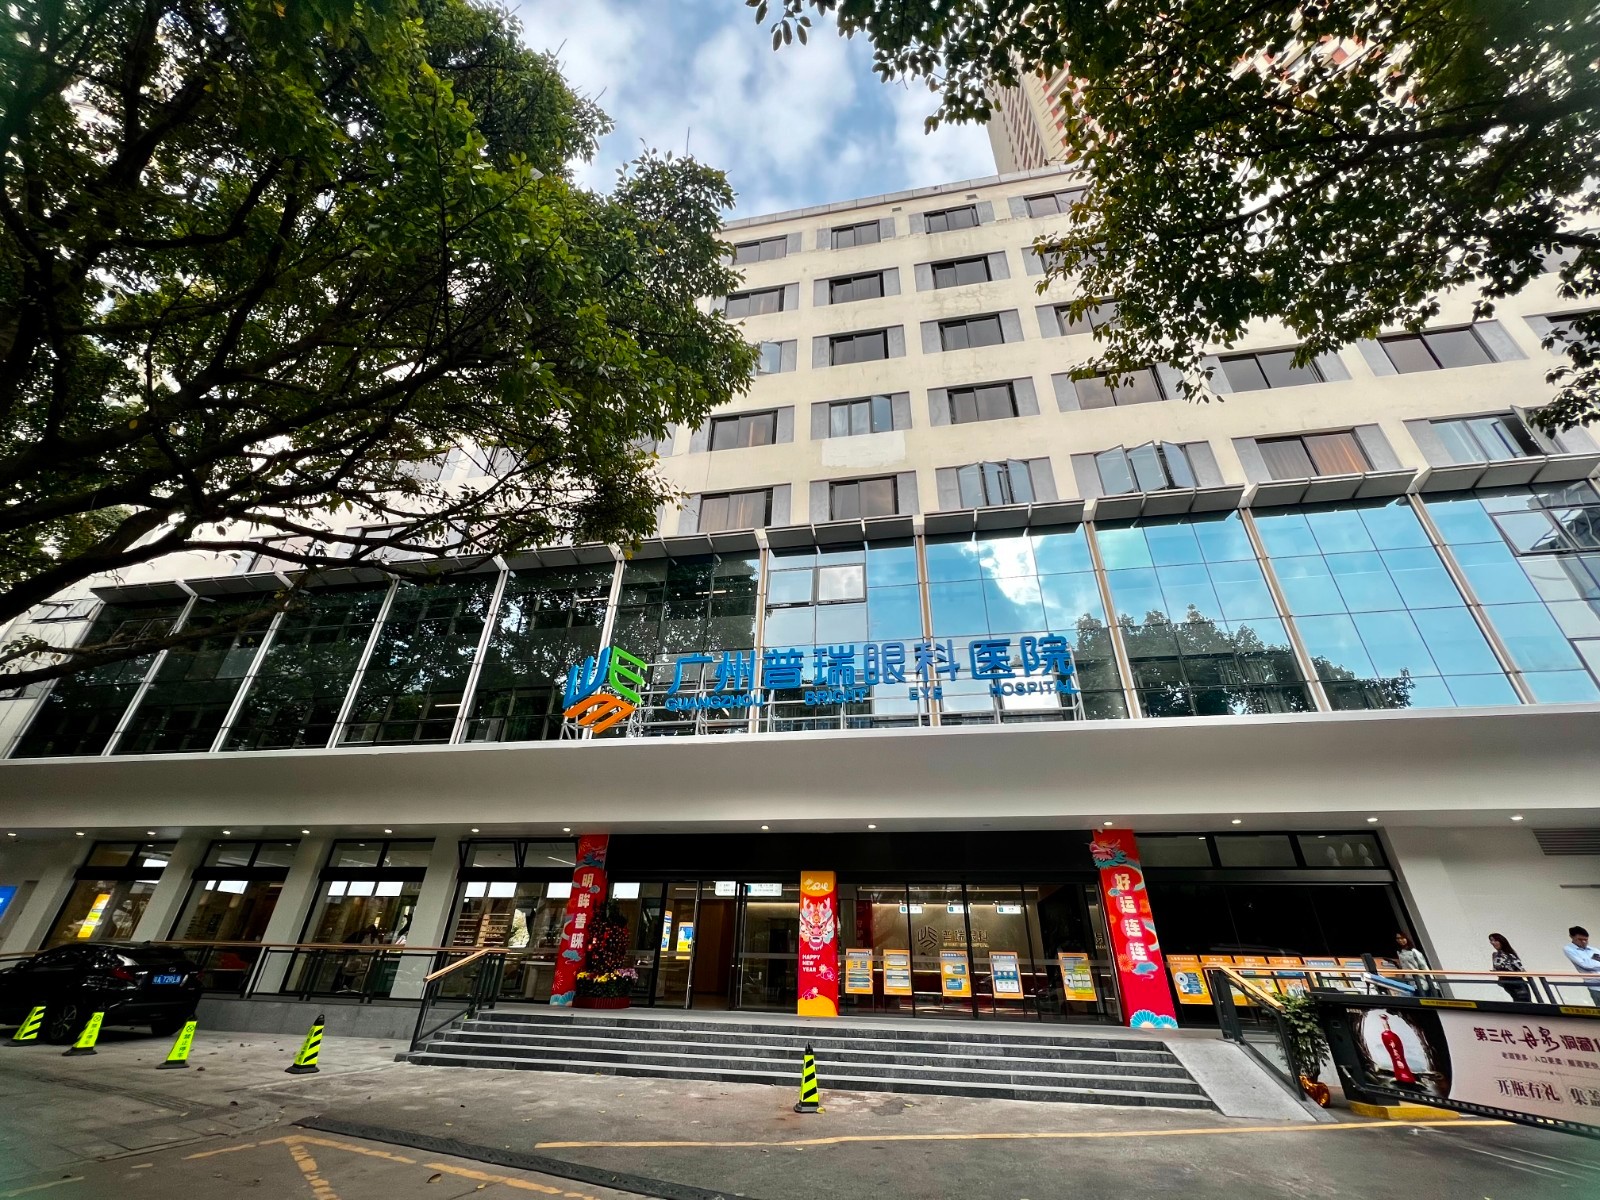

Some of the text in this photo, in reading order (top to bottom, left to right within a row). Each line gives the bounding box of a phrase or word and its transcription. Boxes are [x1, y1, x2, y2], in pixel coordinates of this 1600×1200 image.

[666, 633, 1074, 695] 广州普瑞眼科医院
[665, 679, 1080, 711] GUANGZHOU BRIGHT EYE HOSPITAL
[1114, 873, 1148, 960] 好运连连
[1496, 1079, 1561, 1102] 开瓶有礼
